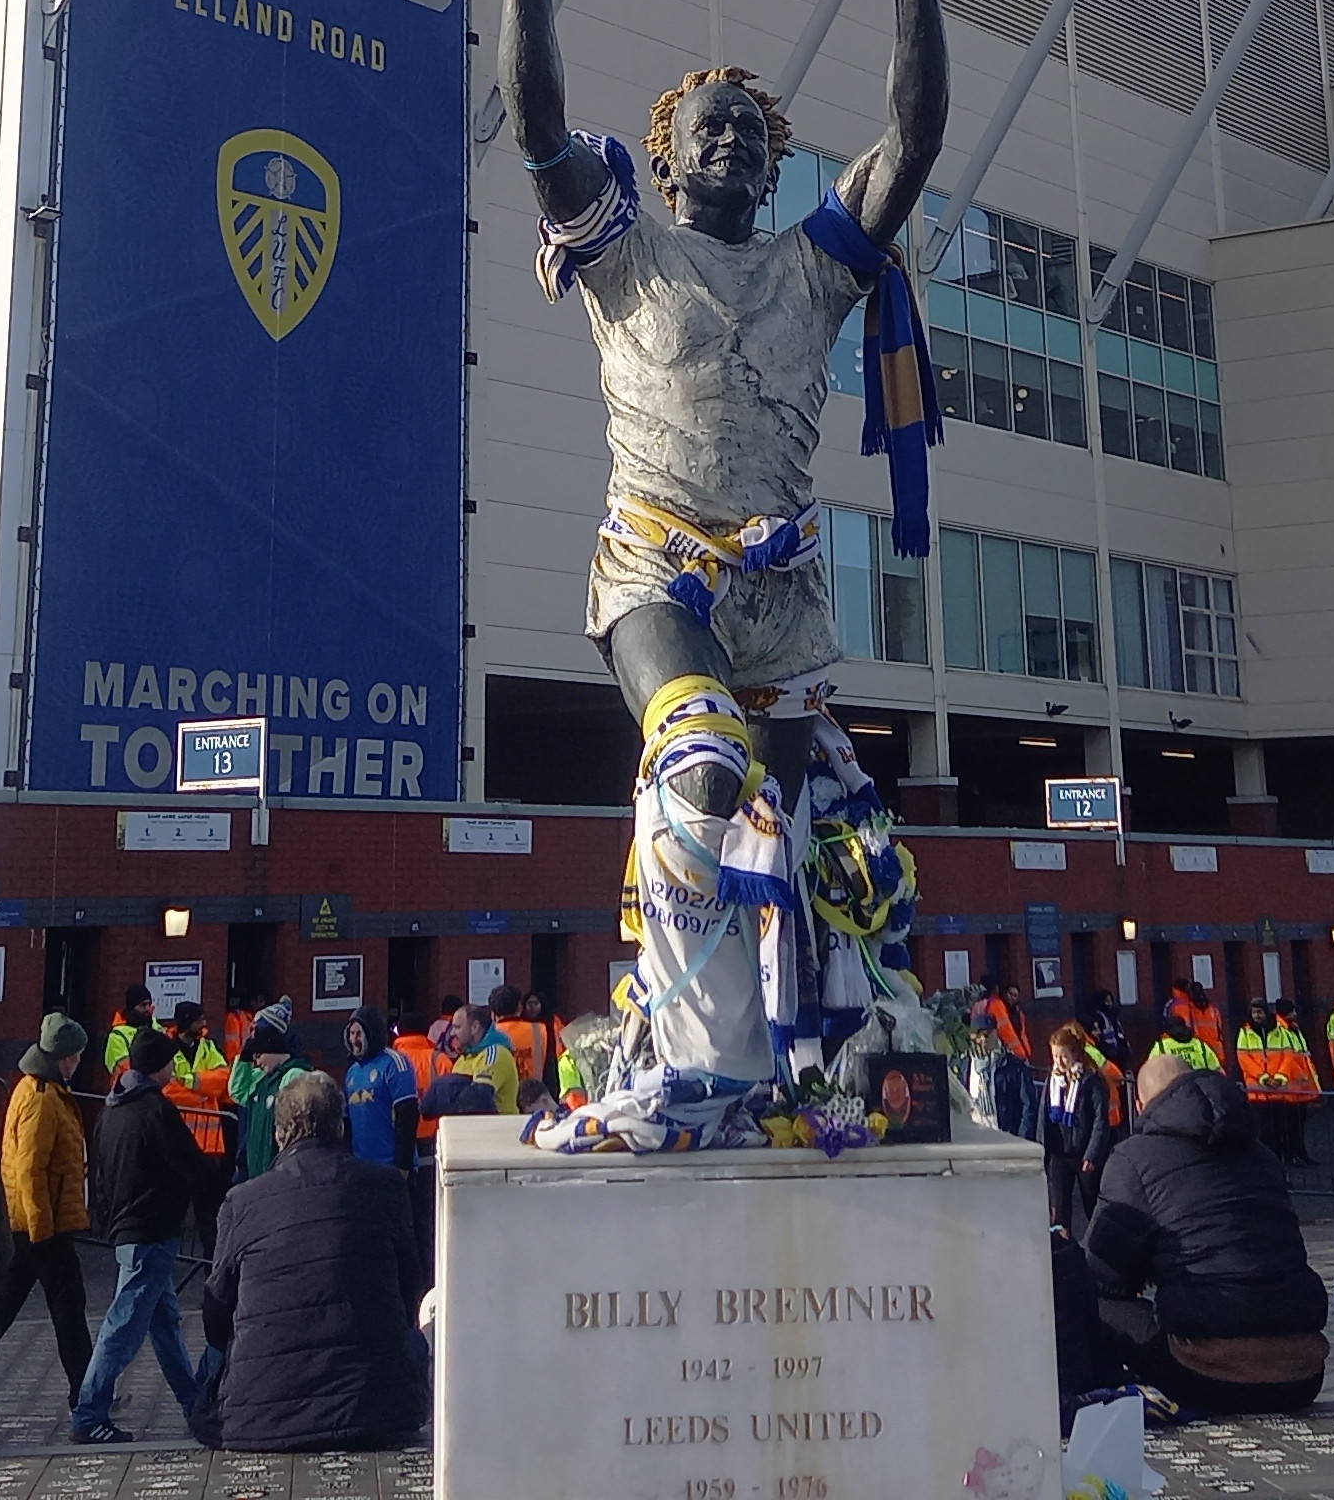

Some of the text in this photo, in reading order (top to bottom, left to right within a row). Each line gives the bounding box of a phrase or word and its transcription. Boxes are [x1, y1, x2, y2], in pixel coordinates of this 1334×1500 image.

[310, 19, 386, 72] ROAD
[83, 660, 428, 726] MARCHING ON
[194, 734, 251, 750] ENTRANCE
[80, 724, 424, 797] TOTHER
[214, 751, 233, 774] 13
[1059, 788, 1107, 800] ENTRANCE
[1076, 801, 1093, 817] 12
[565, 1283, 936, 1329] BILLY BREMNER
[679, 1357, 734, 1382] 1942
[772, 1355, 824, 1380] 1997
[623, 1410, 885, 1446] LEEDS UNITED
[684, 1477, 737, 1500] 1959
[776, 1474, 829, 1500] 1976
